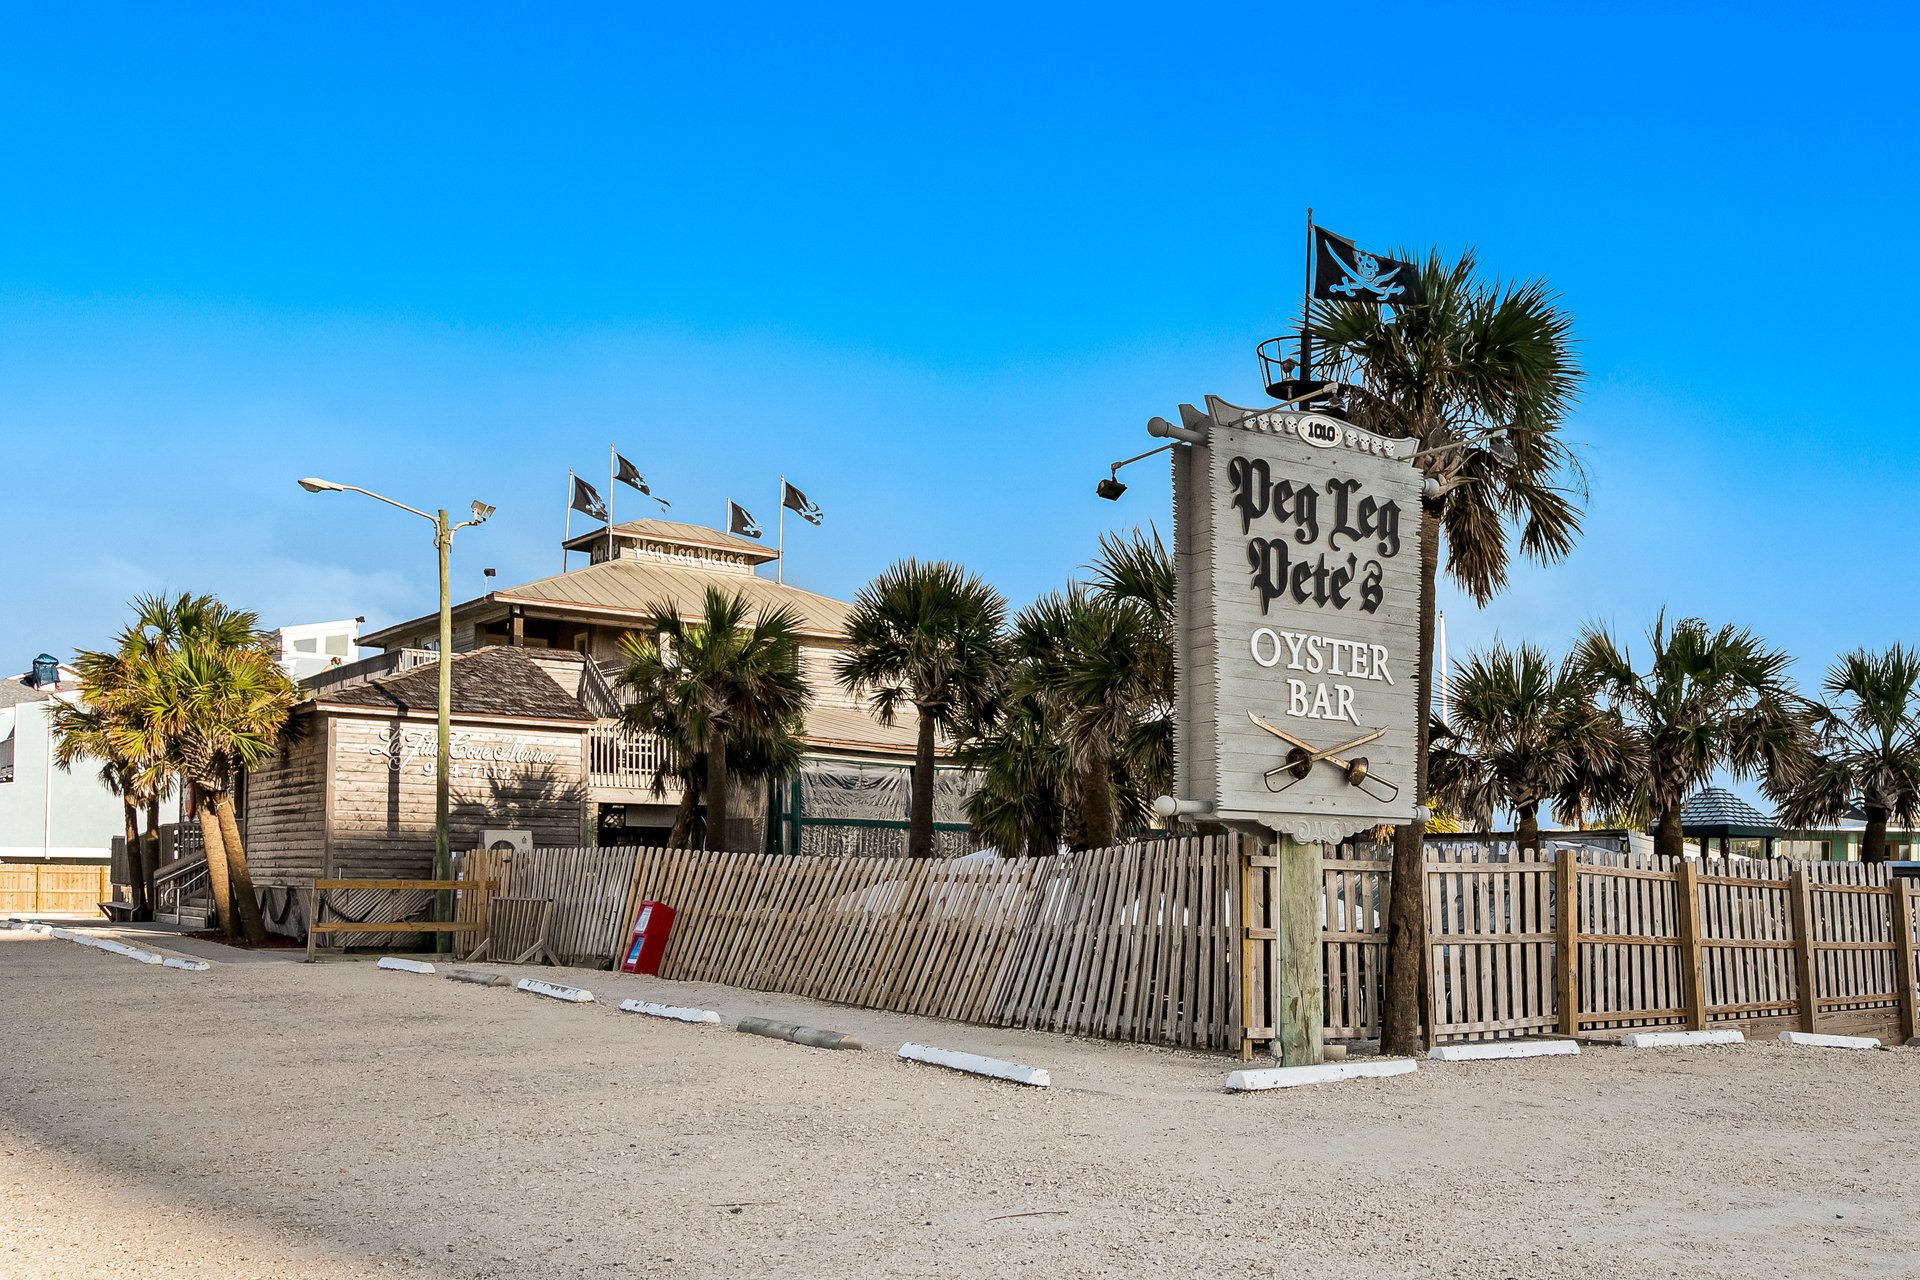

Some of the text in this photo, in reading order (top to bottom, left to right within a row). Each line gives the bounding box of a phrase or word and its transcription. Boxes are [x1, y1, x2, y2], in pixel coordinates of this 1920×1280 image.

[1308, 422, 1336, 442] 1010
[1228, 456, 1402, 558] Peg Leg
[632, 538, 665, 561] Peg
[667, 543, 696, 567] Leg
[698, 547, 745, 568] Pete's
[1247, 537, 1385, 616] Pete's
[1250, 627, 1395, 685] OYSTER
[1286, 678, 1361, 726] BAR
[449, 732, 491, 760] Cove
[492, 737, 557, 764] Marina
[422, 761, 512, 780] 94-7112
